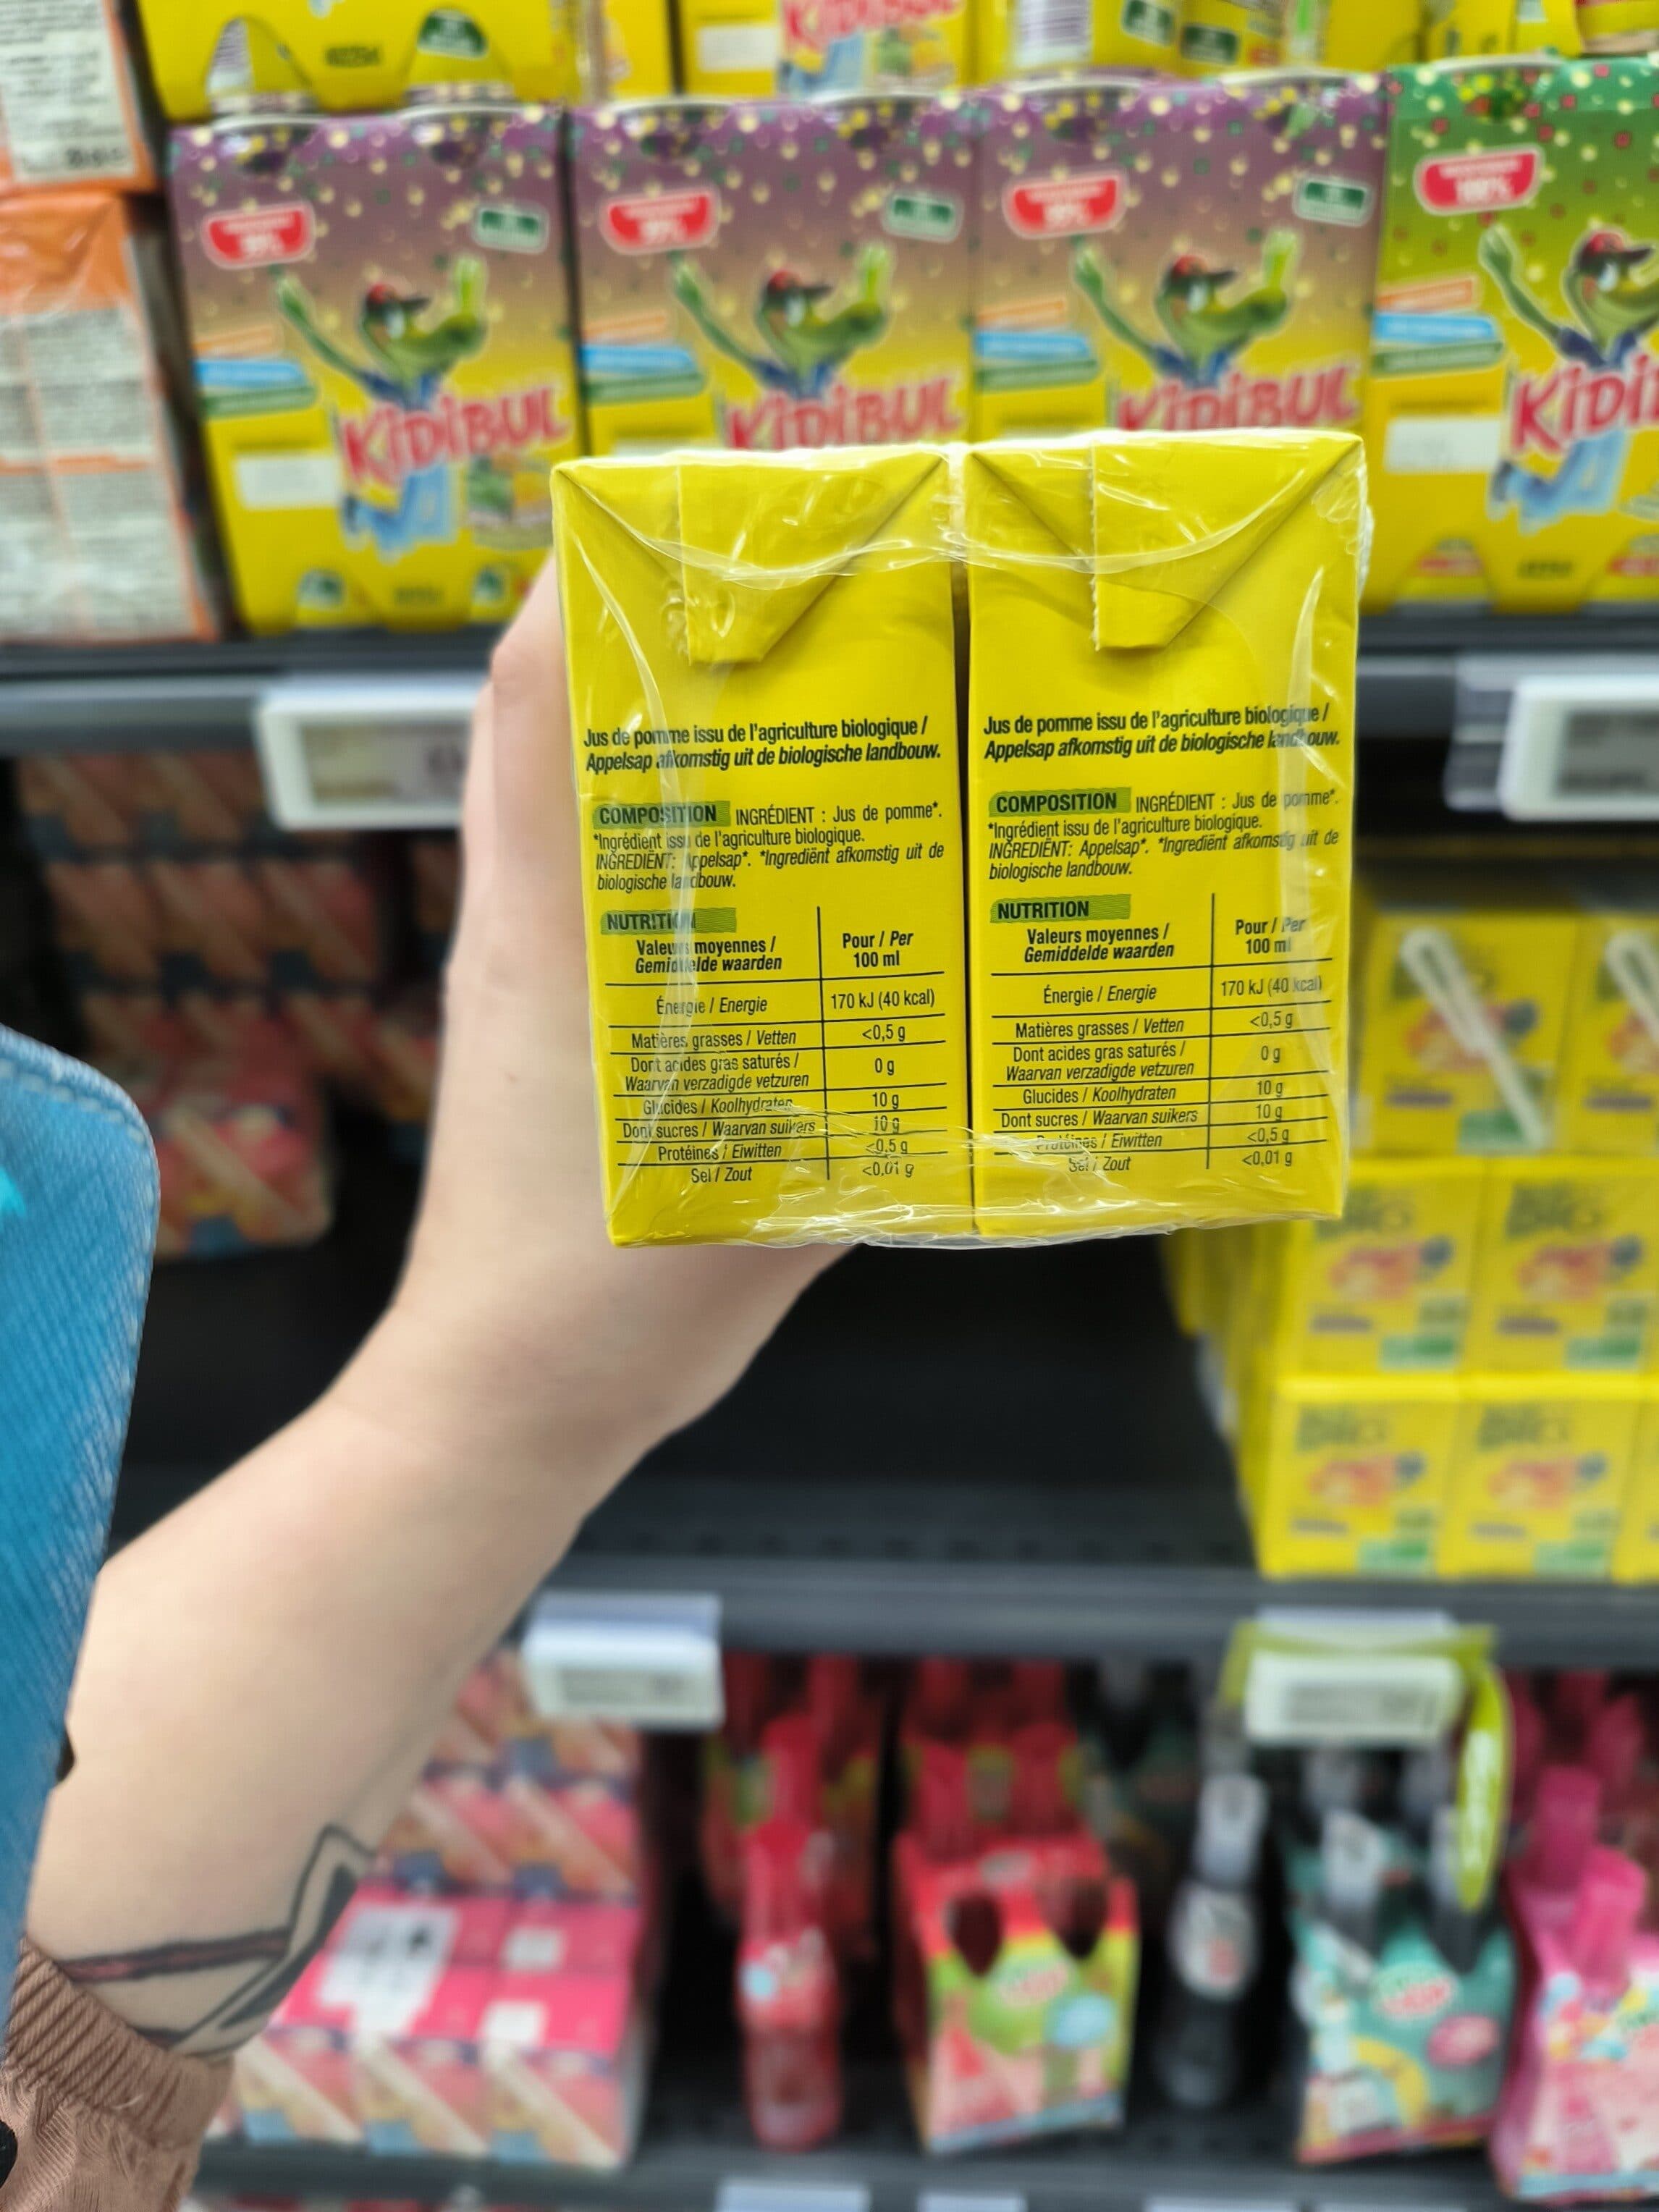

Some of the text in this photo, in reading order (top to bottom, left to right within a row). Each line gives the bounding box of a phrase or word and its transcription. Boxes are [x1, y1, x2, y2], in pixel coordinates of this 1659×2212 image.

[583, 728, 609, 748] Jus
[611, 727, 630, 746] de
[693, 724, 725, 743] issu
[727, 723, 746, 743] de
[748, 720, 839, 746] l'agriculture
[840, 717, 919, 741] biologique
[983, 715, 1011, 735] Jus
[1013, 714, 1034, 735] de
[1036, 716, 1094, 738] pomme
[1096, 712, 1127, 731] issu
[1129, 711, 1149, 730] de
[1151, 707, 1242, 733] l'agriculture
[983, 730, 1265, 764] Appelsap afkomstig uit de biologische
[585, 751, 653, 776] Appelsap
[733, 747, 756, 767] uit
[756, 746, 776, 767] de
[777, 743, 864, 769] biologische
[865, 740, 941, 762] landbouw.
[996, 790, 1277, 814] COMPOSITION INGRÉDIENT Jus de
[735, 803, 816, 826] INGRÉDIENT
[832, 805, 856, 823] Jus
[862, 803, 879, 822] de
[1063, 819, 1090, 837] issu
[1093, 818, 1110, 836] de
[1113, 816, 1191, 838] l'agriculture
[1194, 814, 1262, 835] biologique.
[694, 830, 712, 848] de
[714, 828, 792, 848] l'agriculture
[795, 828, 865, 846] biologique.
[1323, 829, 1339, 845] de
[835, 843, 900, 865] afkomstig
[906, 842, 924, 861] uit
[928, 841, 945, 859] de
[988, 861, 1133, 883] biologische landbouw.
[597, 873, 667, 895] biologische
[997, 900, 1090, 920] NUTRITION
[1026, 926, 1160, 946] Valeurs moyennes
[1235, 919, 1269, 936] Pour
[693, 940, 767, 958] moyennes
[842, 930, 915, 950] Pour Per
[1245, 937, 1271, 955] 100
[853, 949, 900, 968] 100 ml
[1023, 941, 1175, 963] Gemiddelde waarden
[722, 953, 782, 972] waarden
[1043, 983, 1157, 1007] Énergie Energie
[1220, 979, 1245, 997] 170
[1248, 978, 1265, 995] kJ
[1267, 977, 1289, 997] (40
[719, 995, 768, 1016] Energie
[830, 988, 935, 1011] 170 kJ (40 kcal)
[1015, 1017, 1185, 1039] Matières grasses Vetten
[1249, 1010, 1294, 1029] <0,5 g
[692, 1033, 743, 1048] grasses
[756, 1029, 797, 1046] Vetten
[861, 1023, 906, 1043] <0,5 g
[742, 1052, 791, 1071] saturés
[1013, 1040, 1177, 1064] Dont acides gras saturés
[1260, 1045, 1281, 1064] 0 g
[874, 1057, 895, 1076] 0 g
[1006, 1061, 1195, 1081] Waarvan verzadigde vetzuren
[625, 1072, 810, 1092] Waarvan verzadigde vetzuren
[1257, 1079, 1284, 1097] 10 g
[871, 1091, 899, 1109] 10 g
[1022, 1086, 1176, 1105] Glucides Koolhydraten
[1001, 1107, 1199, 1128] Dont sucres Waarvan suikers
[1255, 1103, 1283, 1120] 10 g
[655, 1125, 699, 1139] sucres
[712, 1120, 767, 1137] Waarvan
[892, 1118, 900, 1133] g
[1246, 1126, 1289, 1144] <0,5 g
[900, 1140, 908, 1154] g
[1110, 1131, 1163, 1149] Eiwitten
[657, 1142, 782, 1162] Protéines Eiwitten
[1241, 1149, 1293, 1168] <0,01 g
[1102, 1155, 1132, 1172] Zout
[691, 1165, 753, 1184] Sel Zout
